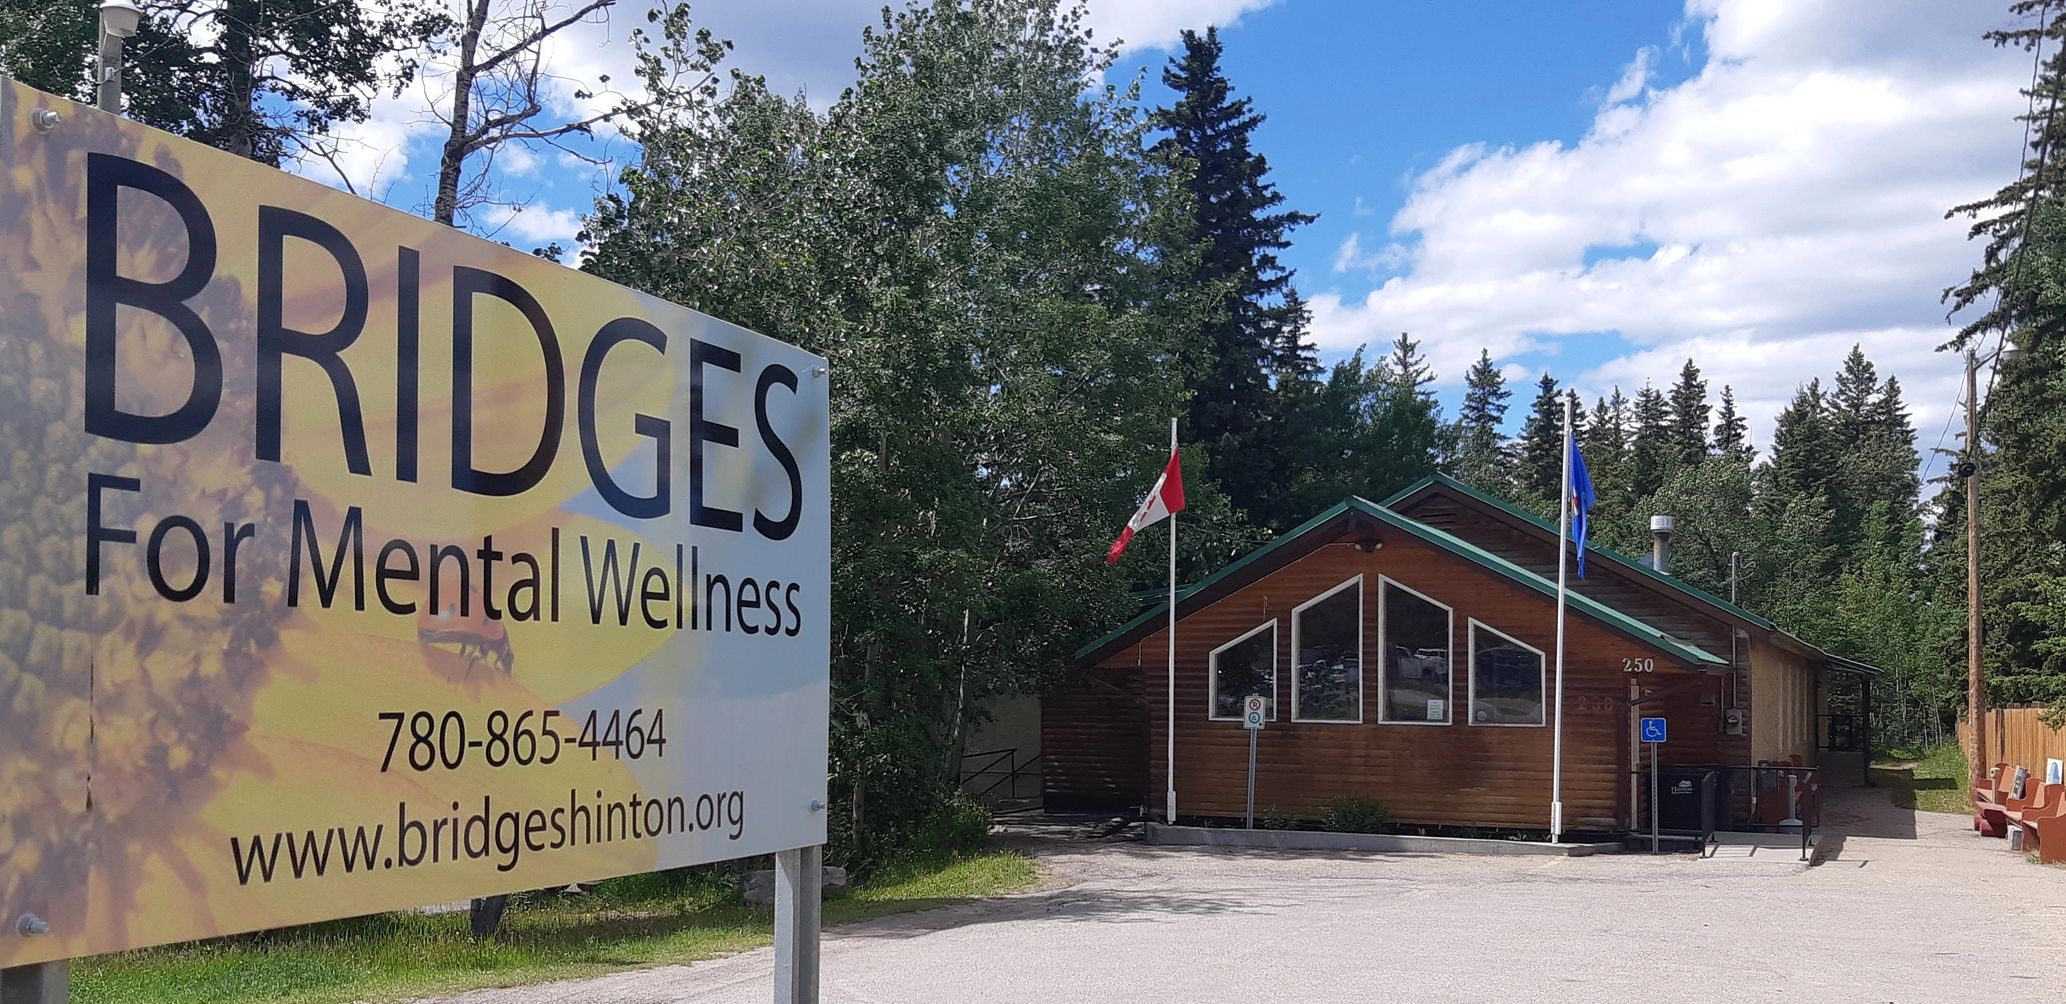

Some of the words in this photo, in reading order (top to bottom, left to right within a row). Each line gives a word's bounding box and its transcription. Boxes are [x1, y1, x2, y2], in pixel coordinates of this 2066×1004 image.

[85, 152, 803, 541] BRIDGES
[86, 473, 255, 603] For
[287, 498, 560, 623] Mental
[580, 534, 802, 637] Wellness
[1622, 657, 1654, 673] 250
[378, 708, 667, 773] 780-865-4464
[230, 788, 745, 884] www.bridgeshinton.org
